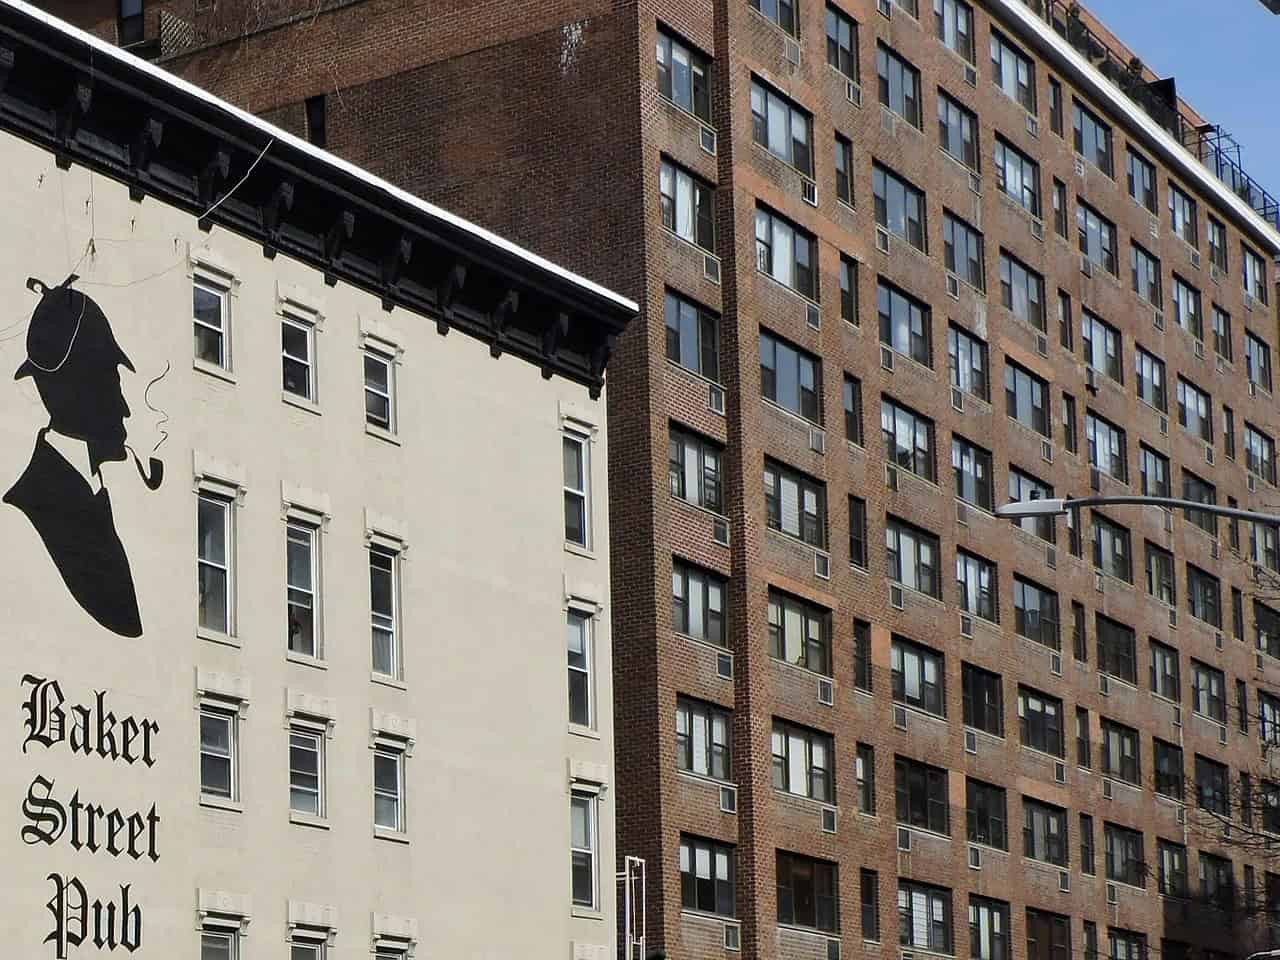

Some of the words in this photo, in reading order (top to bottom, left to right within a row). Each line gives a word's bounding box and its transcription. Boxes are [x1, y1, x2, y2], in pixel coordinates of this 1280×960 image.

[21, 674, 160, 768] Baker
[21, 774, 160, 863] Street
[43, 872, 142, 960] Pub
